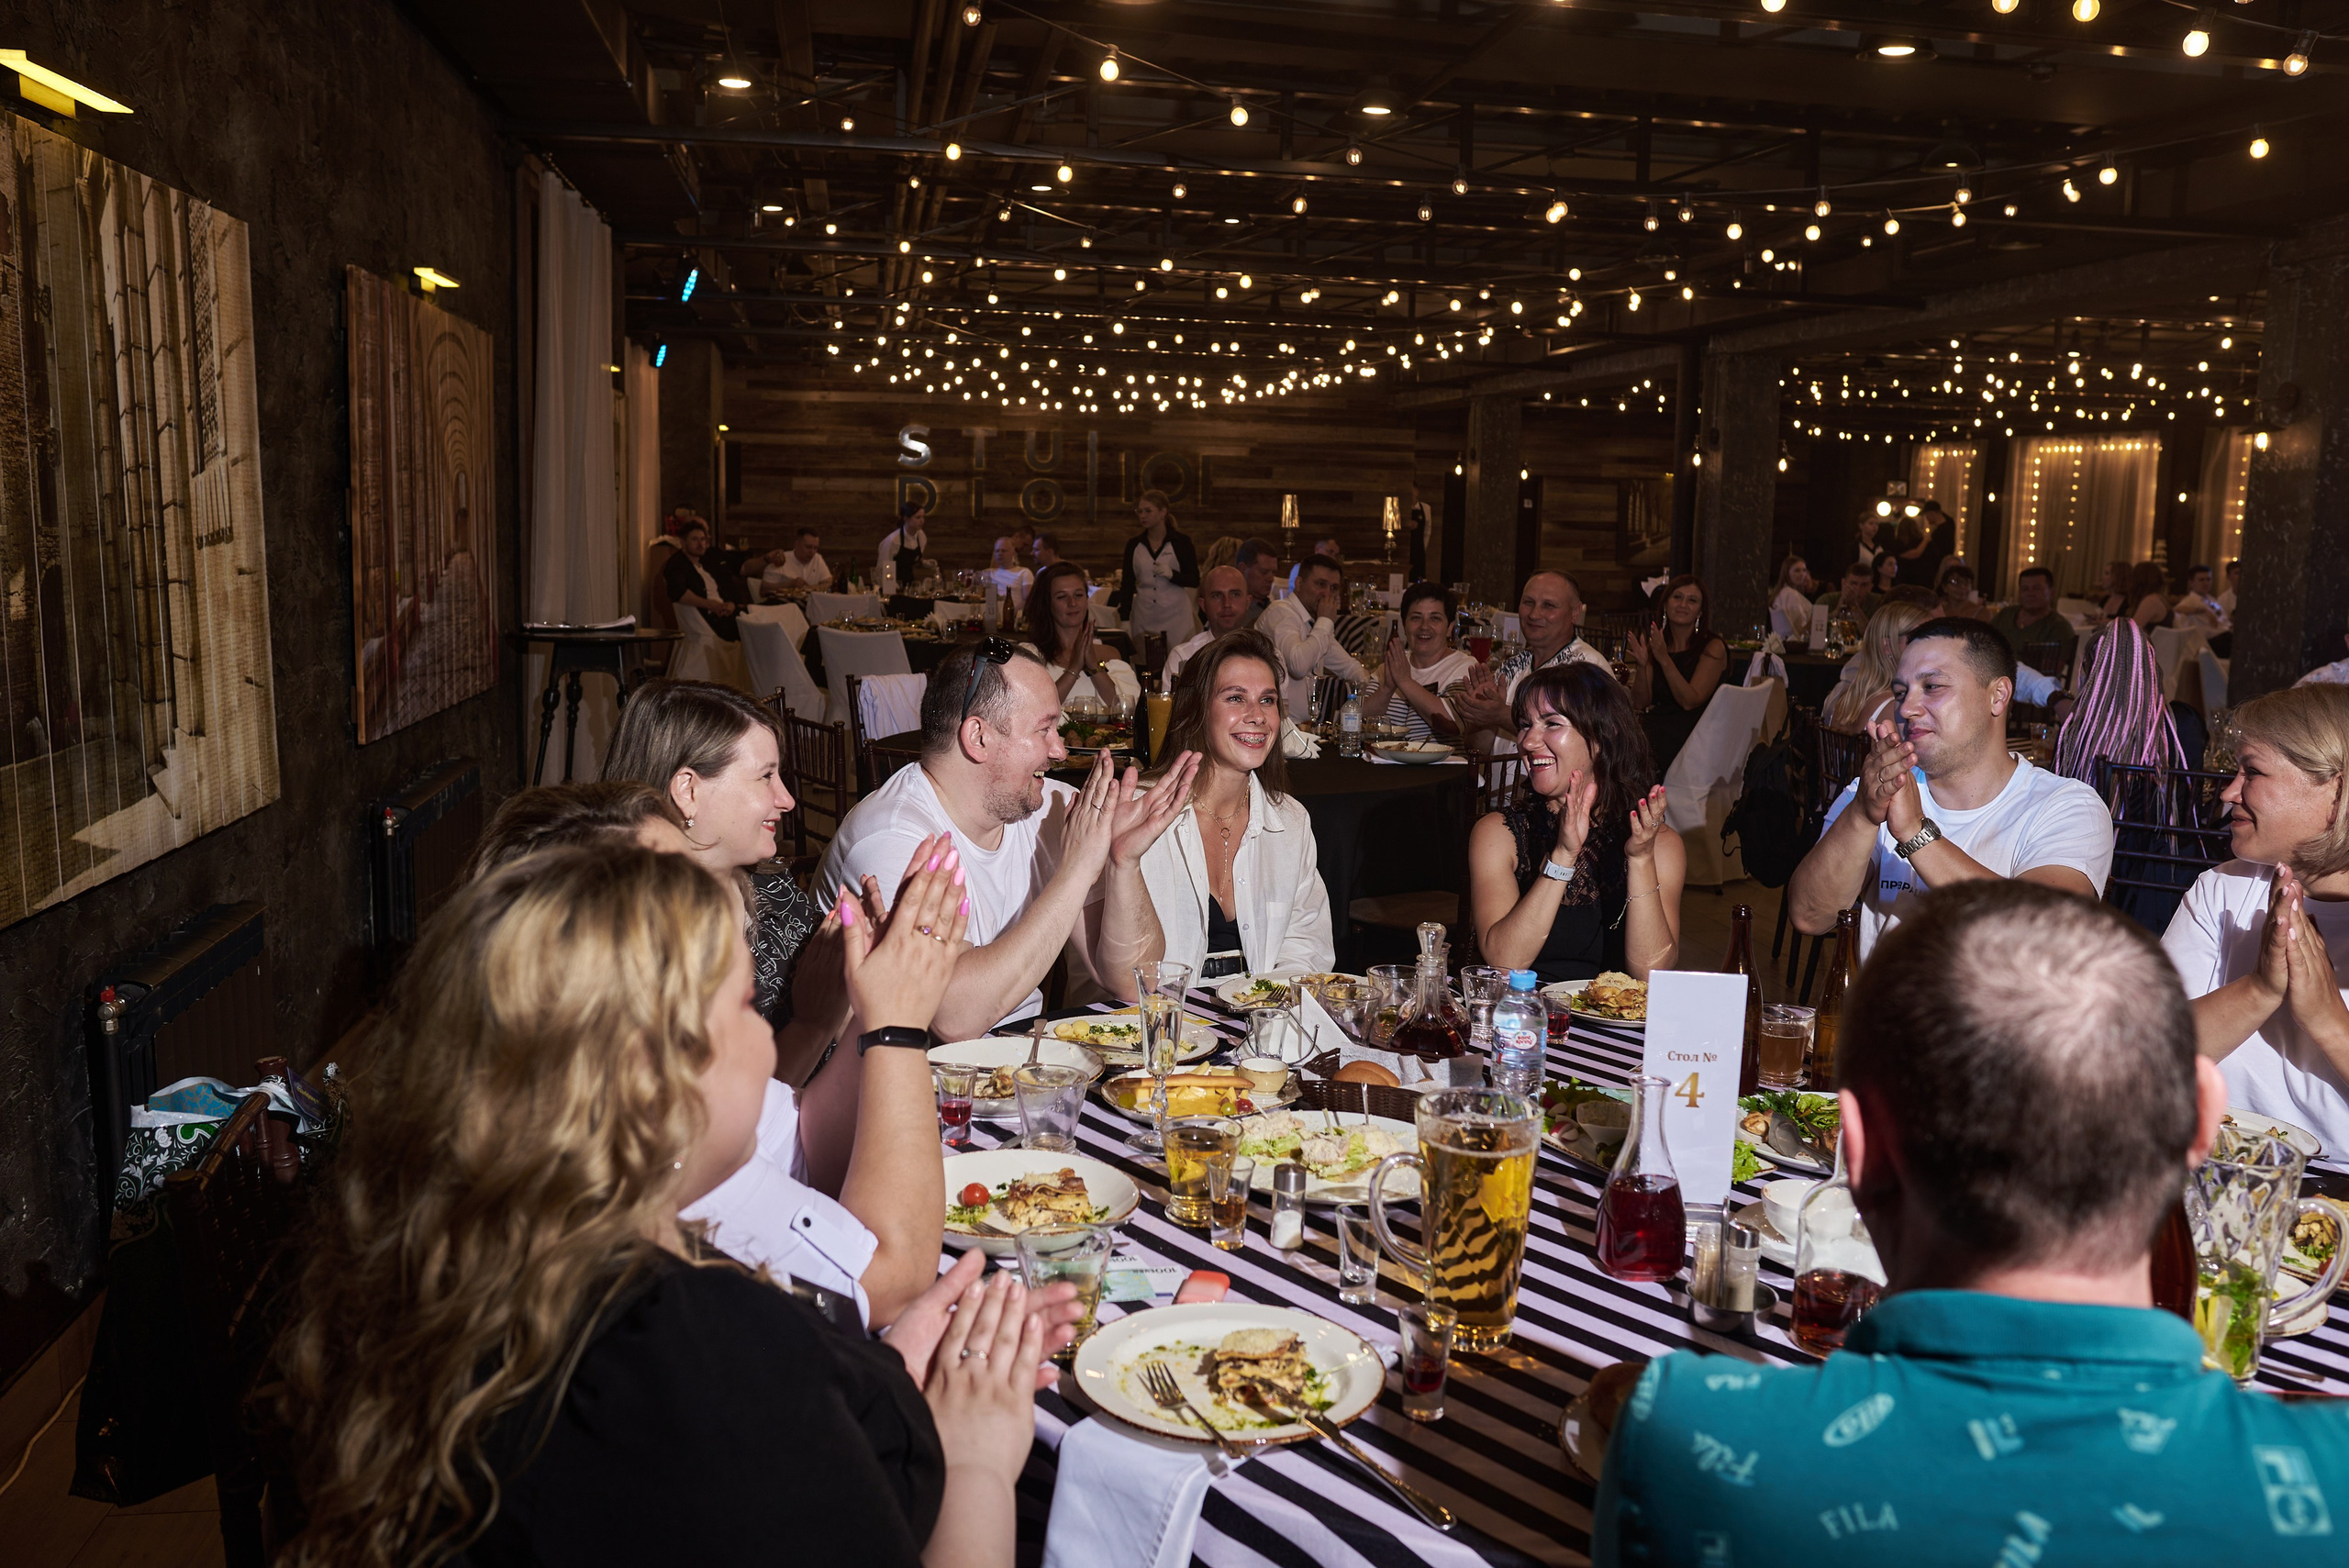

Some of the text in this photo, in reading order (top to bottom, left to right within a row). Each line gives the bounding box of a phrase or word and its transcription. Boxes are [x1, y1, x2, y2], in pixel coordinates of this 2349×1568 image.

[1667, 1051, 1718, 1062] Стол №
[1675, 1072, 1705, 1108] 4
[1819, 1501, 1899, 1540] FILA
